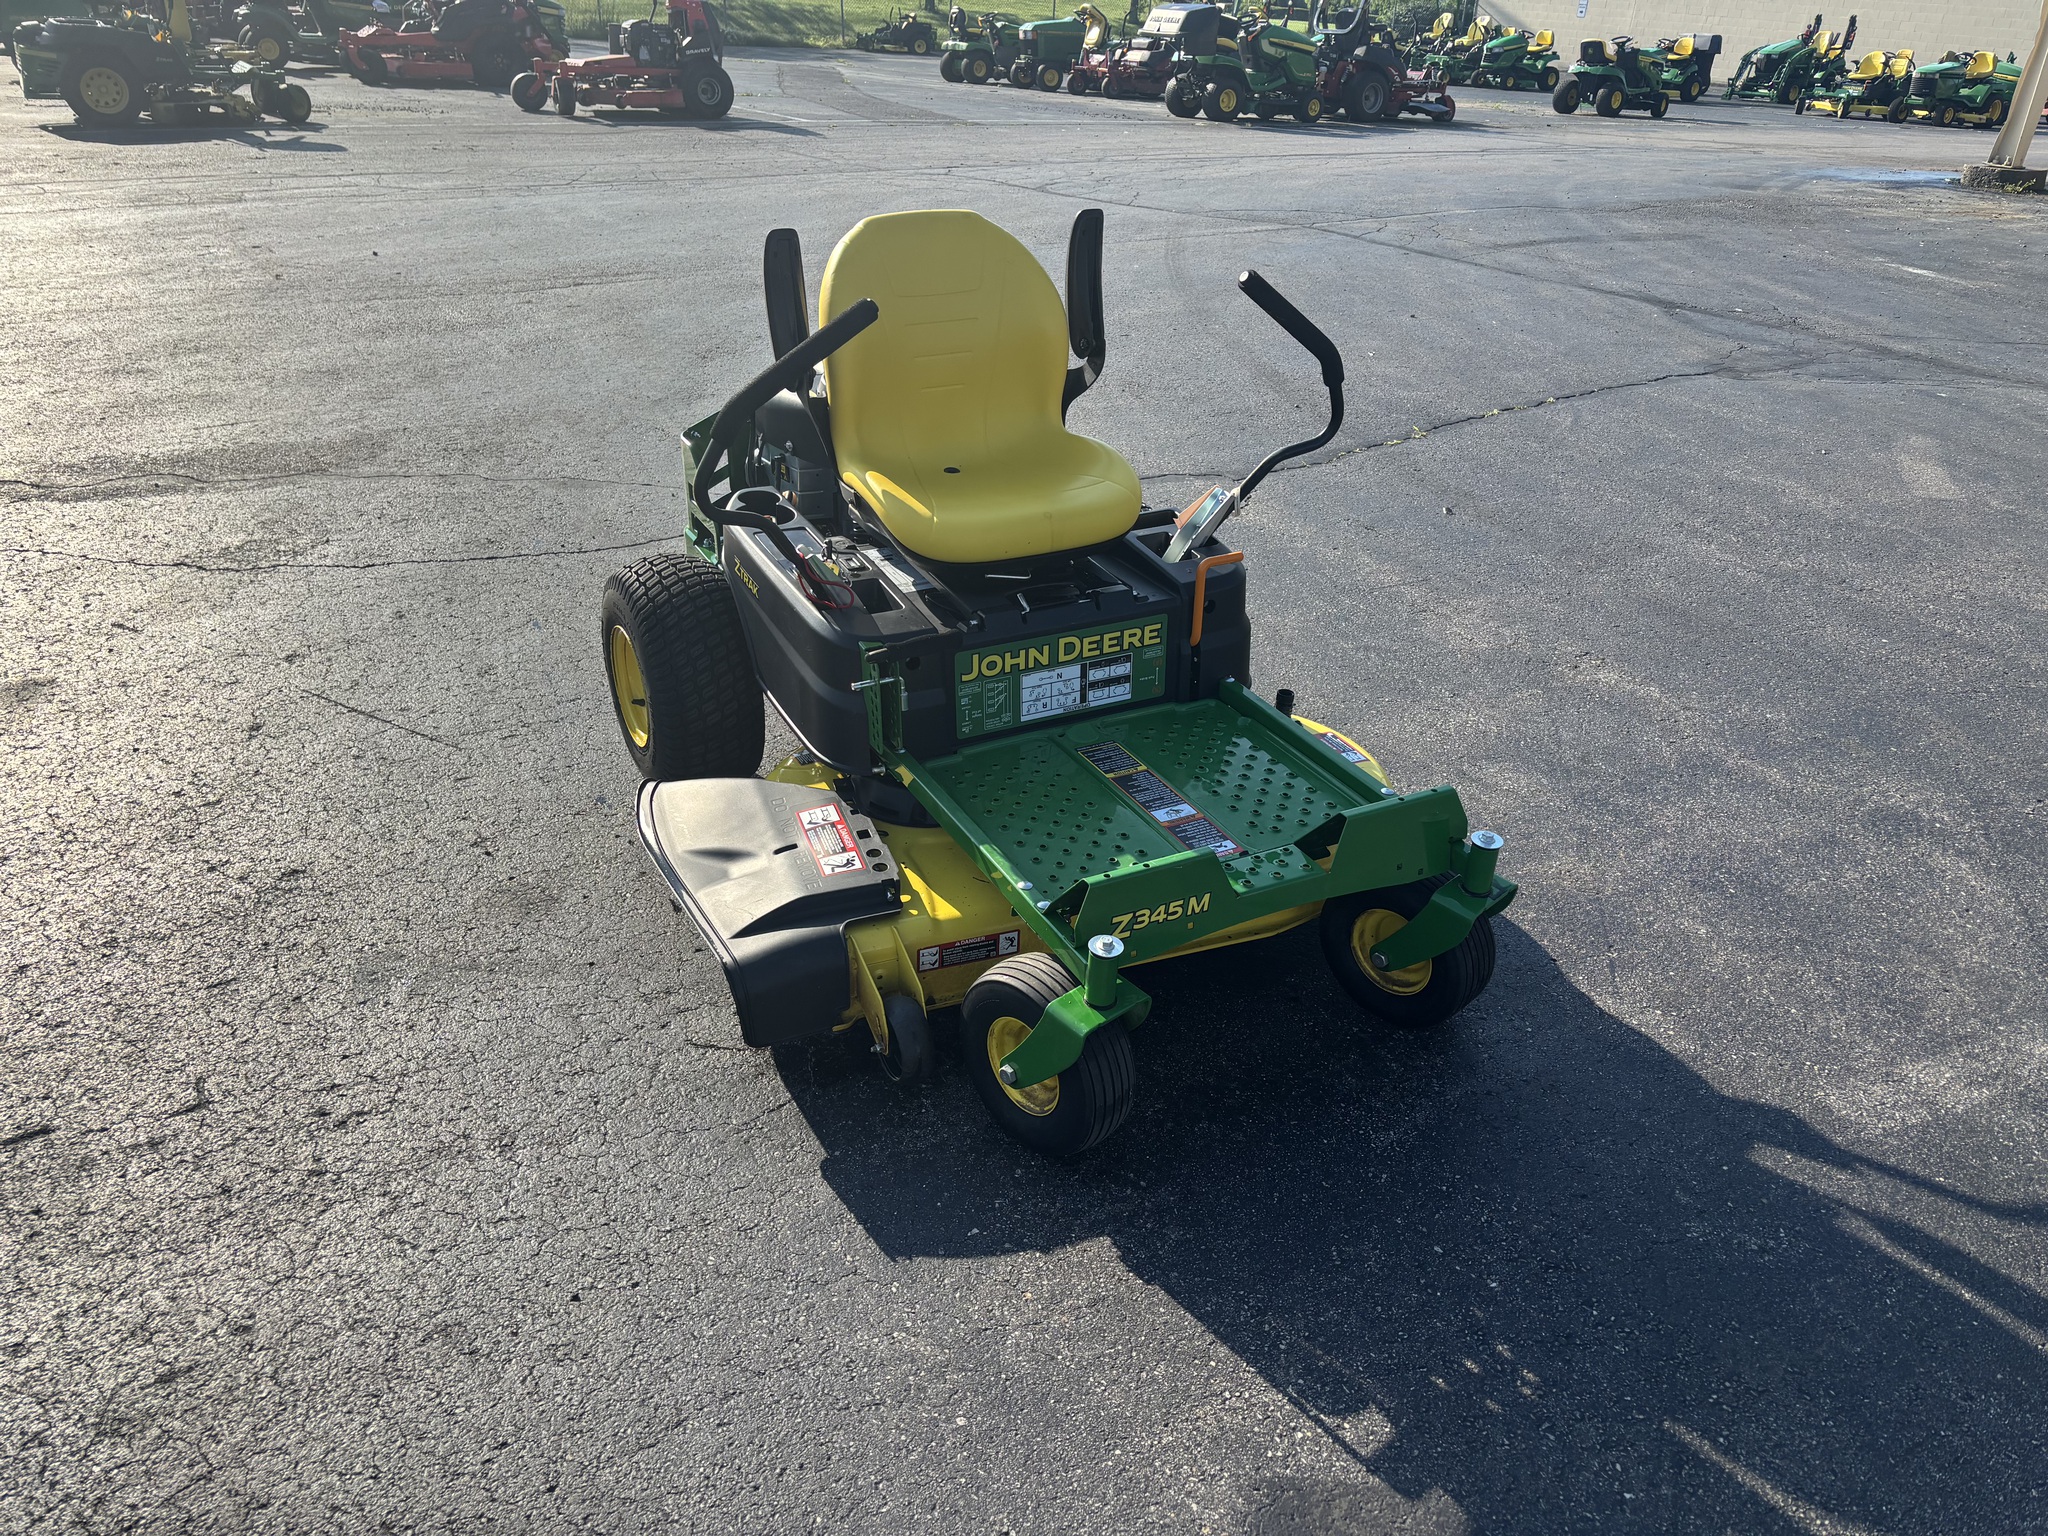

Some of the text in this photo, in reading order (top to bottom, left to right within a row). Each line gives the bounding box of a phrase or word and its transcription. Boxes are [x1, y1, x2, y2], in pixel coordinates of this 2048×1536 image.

[685, 47, 711, 55] GRAVELY
[733, 554, 760, 599] ZTRAK
[961, 623, 1162, 682] JOHN DEERE
[1056, 672, 1063, 680] N
[1042, 701, 1048, 709] R
[839, 828, 855, 849] DANGER
[960, 936, 986, 946] DANGER
